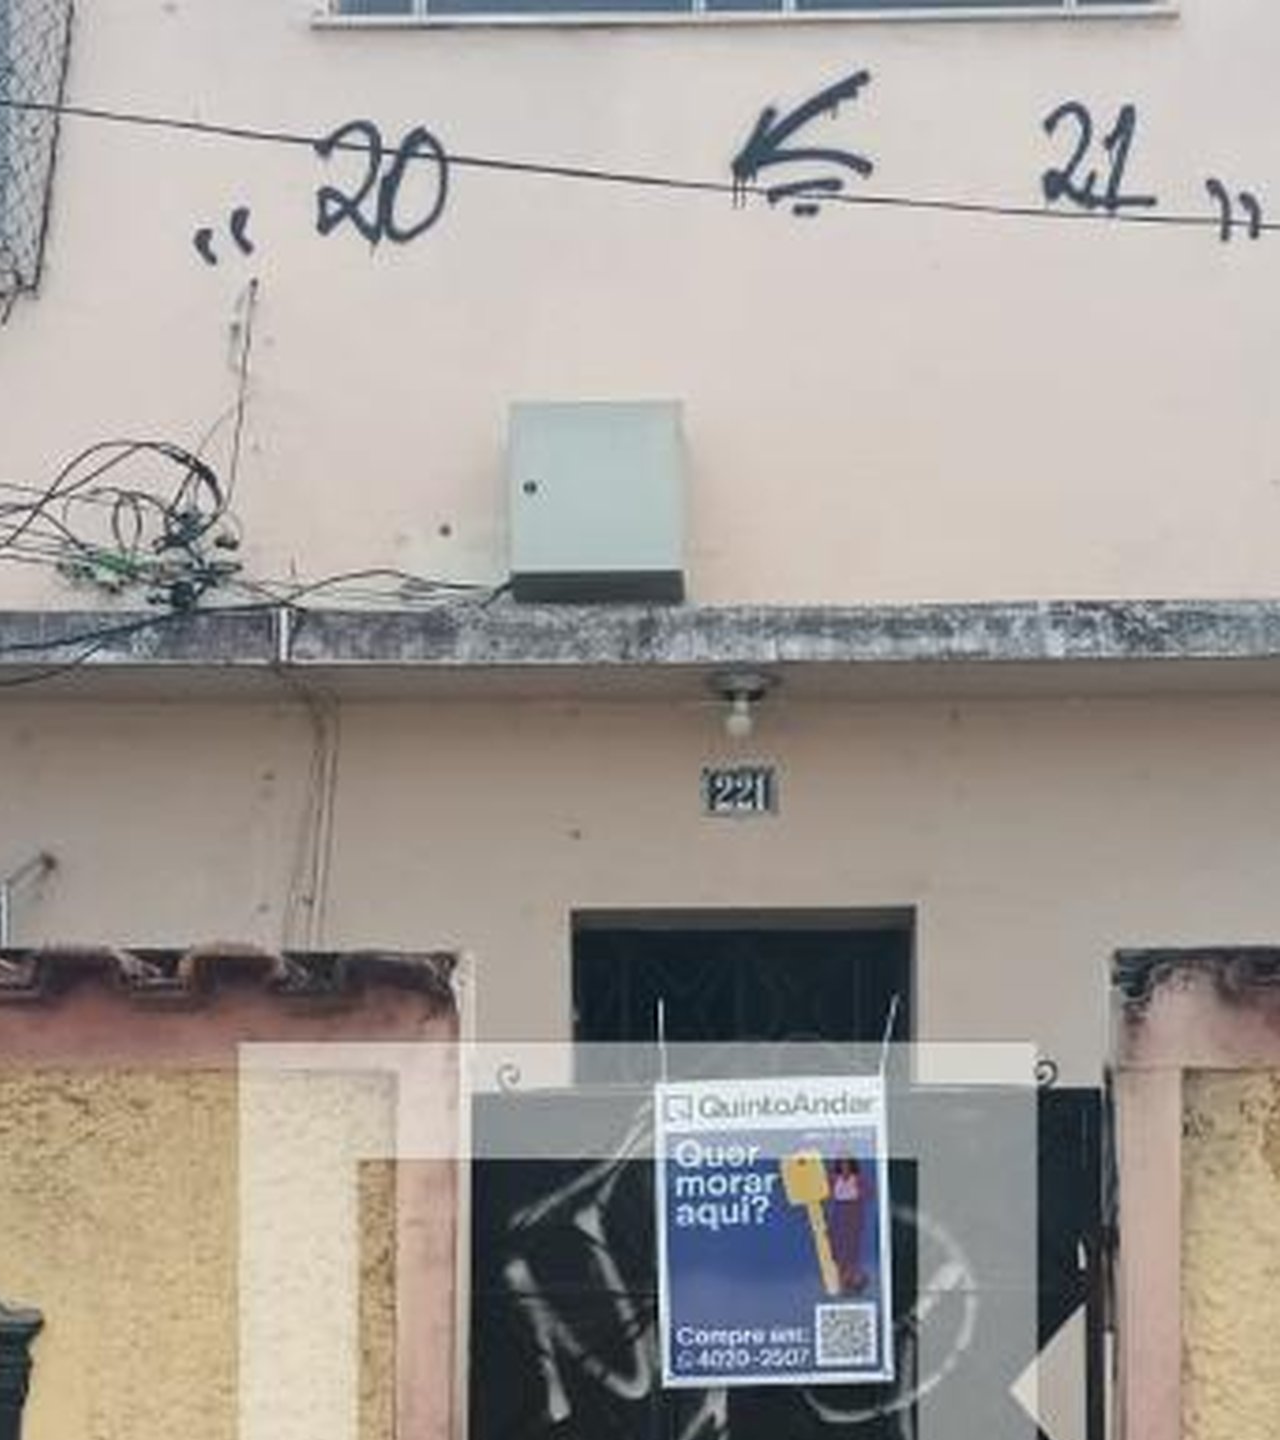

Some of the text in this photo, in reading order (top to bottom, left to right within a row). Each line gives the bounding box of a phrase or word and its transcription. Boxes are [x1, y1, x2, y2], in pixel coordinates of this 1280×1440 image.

[715, 775, 765, 811] 221
[699, 1091, 874, 1118] QuintoAndar
[675, 1140, 761, 1168] Quer
[675, 1172, 780, 1197] morar
[675, 1196, 770, 1230] aqui?
[675, 1327, 766, 1347] Compre
